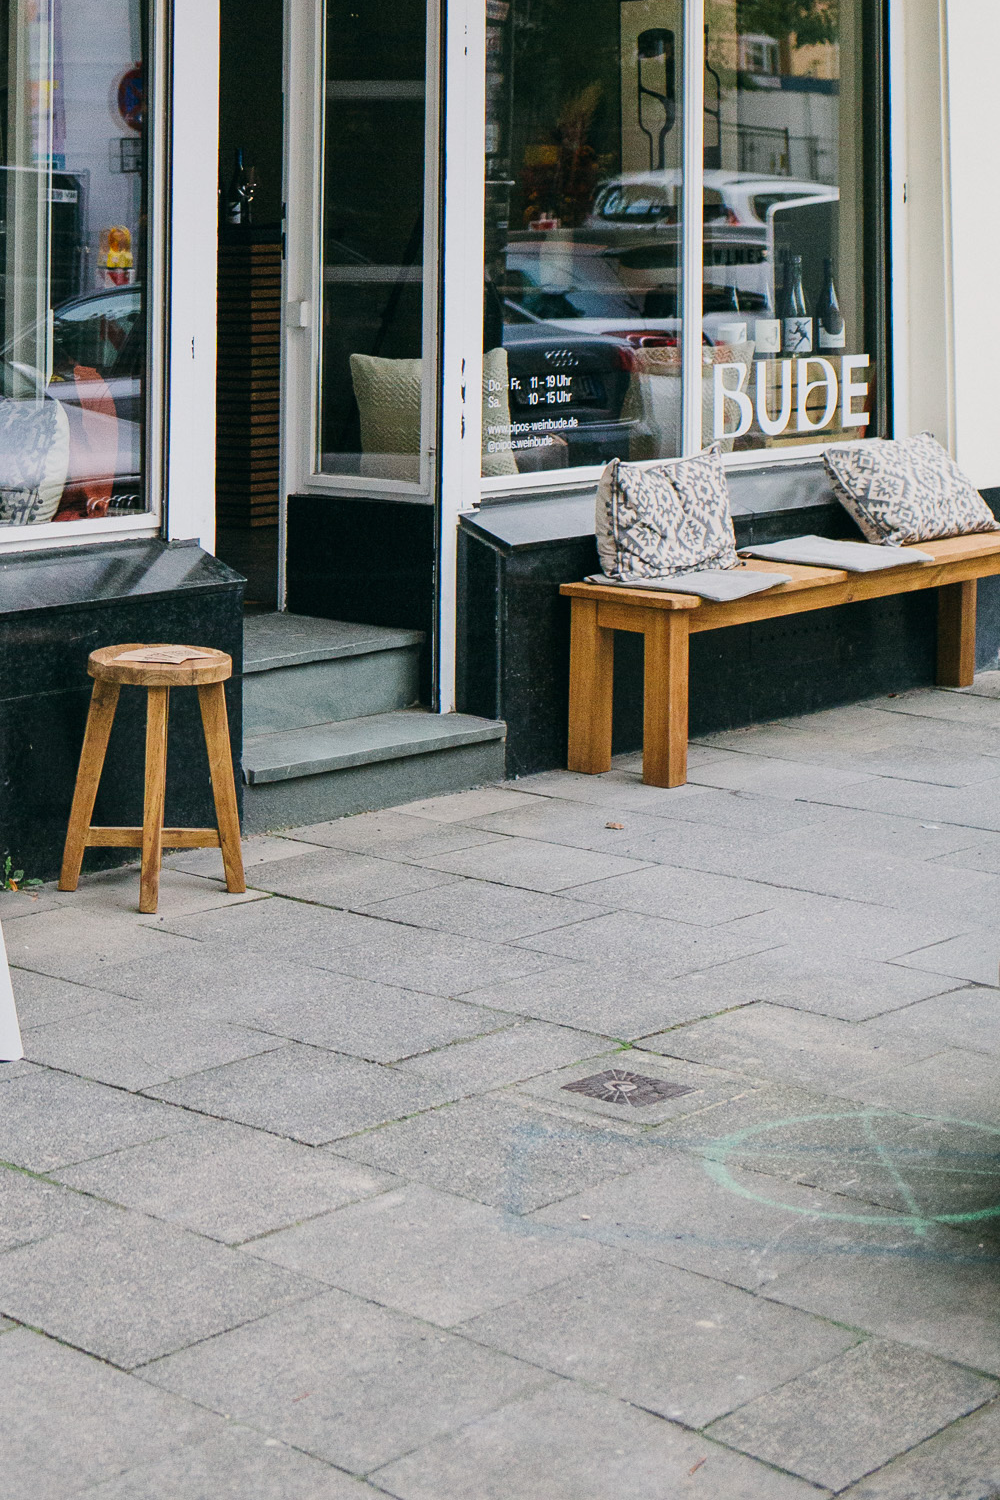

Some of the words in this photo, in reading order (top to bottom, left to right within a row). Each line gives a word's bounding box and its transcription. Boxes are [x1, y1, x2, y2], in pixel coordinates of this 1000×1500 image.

[510, 377, 521, 390] Fr.
[556, 374, 572, 387] Uhr
[487, 395, 501, 408] Sa.
[556, 390, 572, 403] Uhr
[713, 353, 870, 440] BUDE
[487, 416, 579, 435] www.pipos-weinbude.de
[487, 434, 554, 453] @pipos.weinbude
